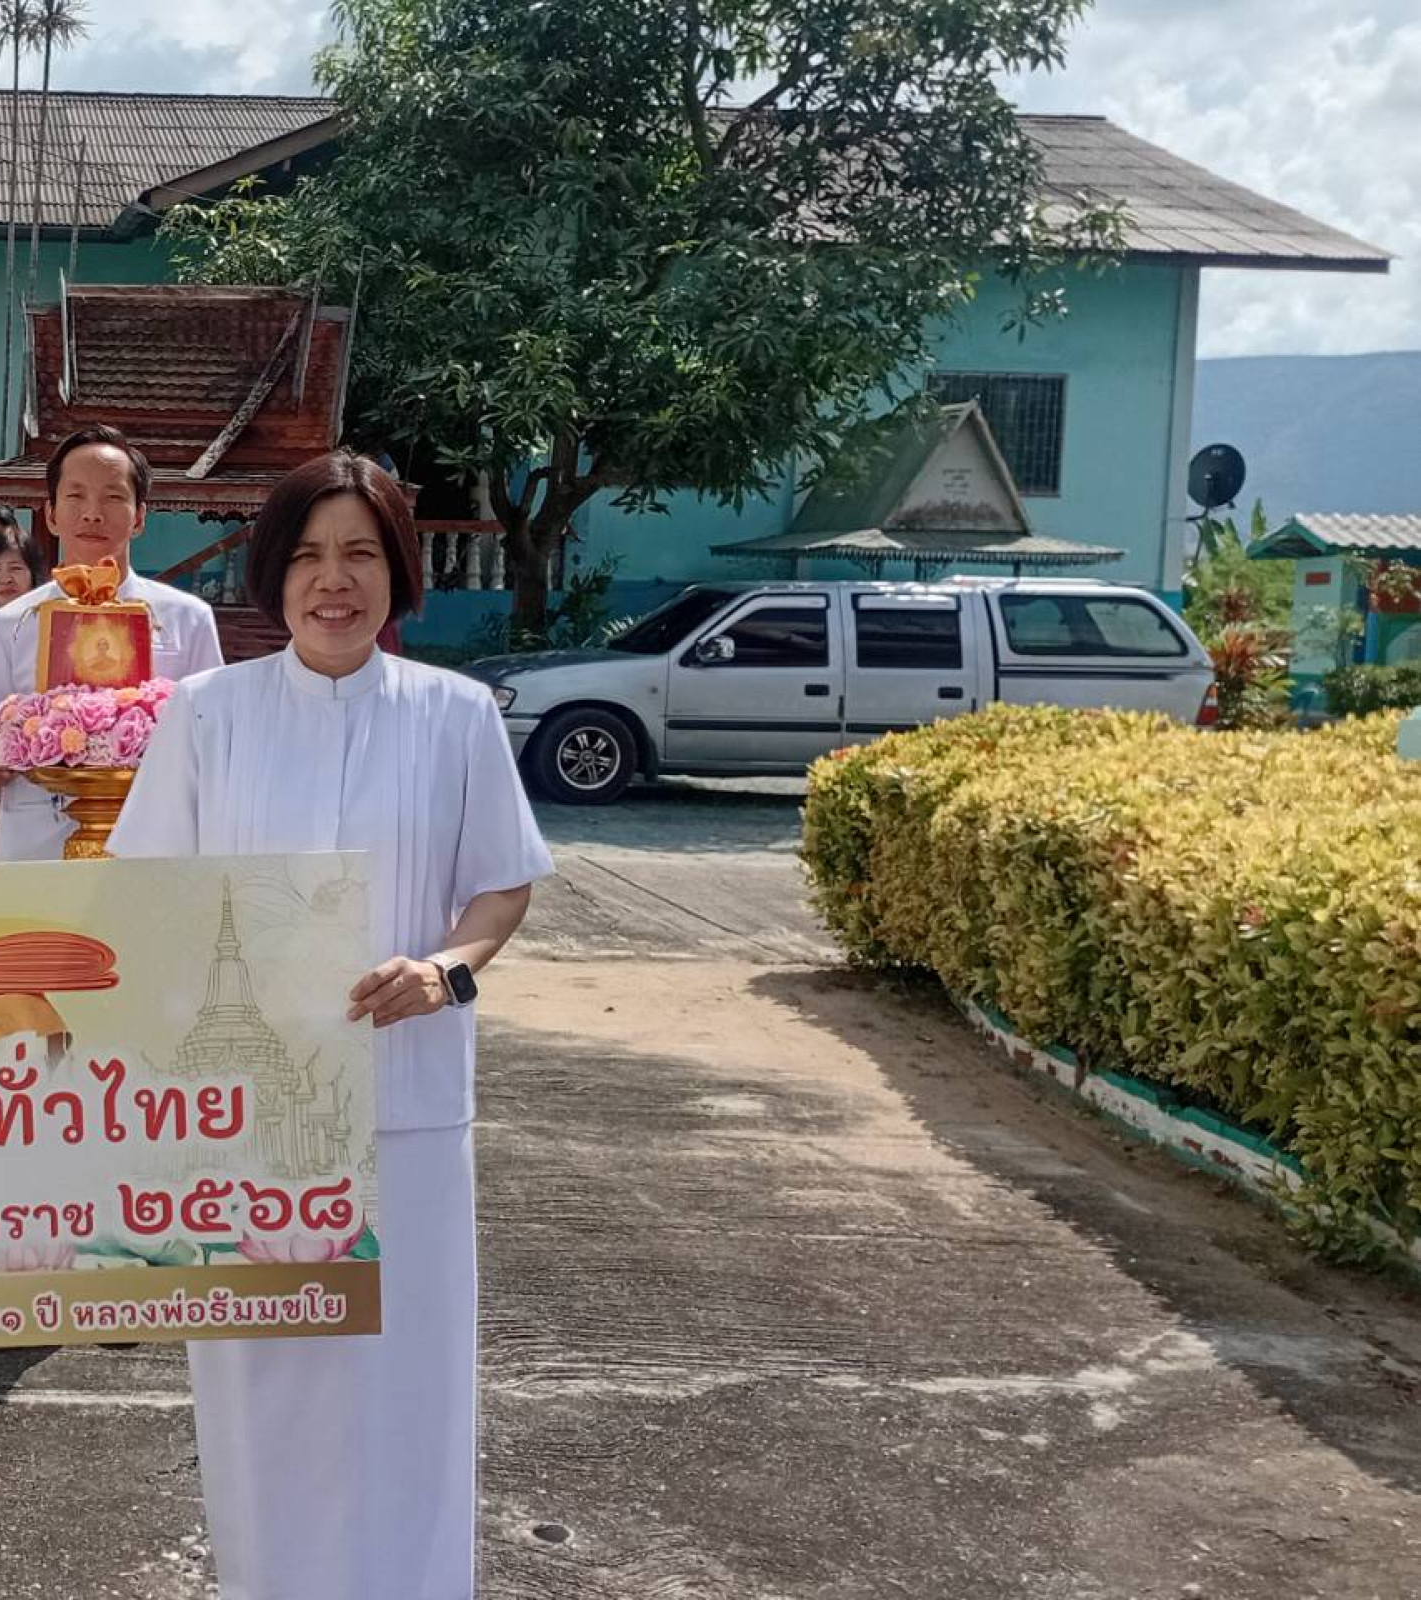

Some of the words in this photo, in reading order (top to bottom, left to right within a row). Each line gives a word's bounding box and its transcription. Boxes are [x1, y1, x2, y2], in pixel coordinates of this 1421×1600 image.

[118, 1177, 354, 1236] ๒๕๖๘
[35, 1295, 59, 1327] ปี
[73, 1286, 345, 1328] หลวงพ่อธัมมชโย
